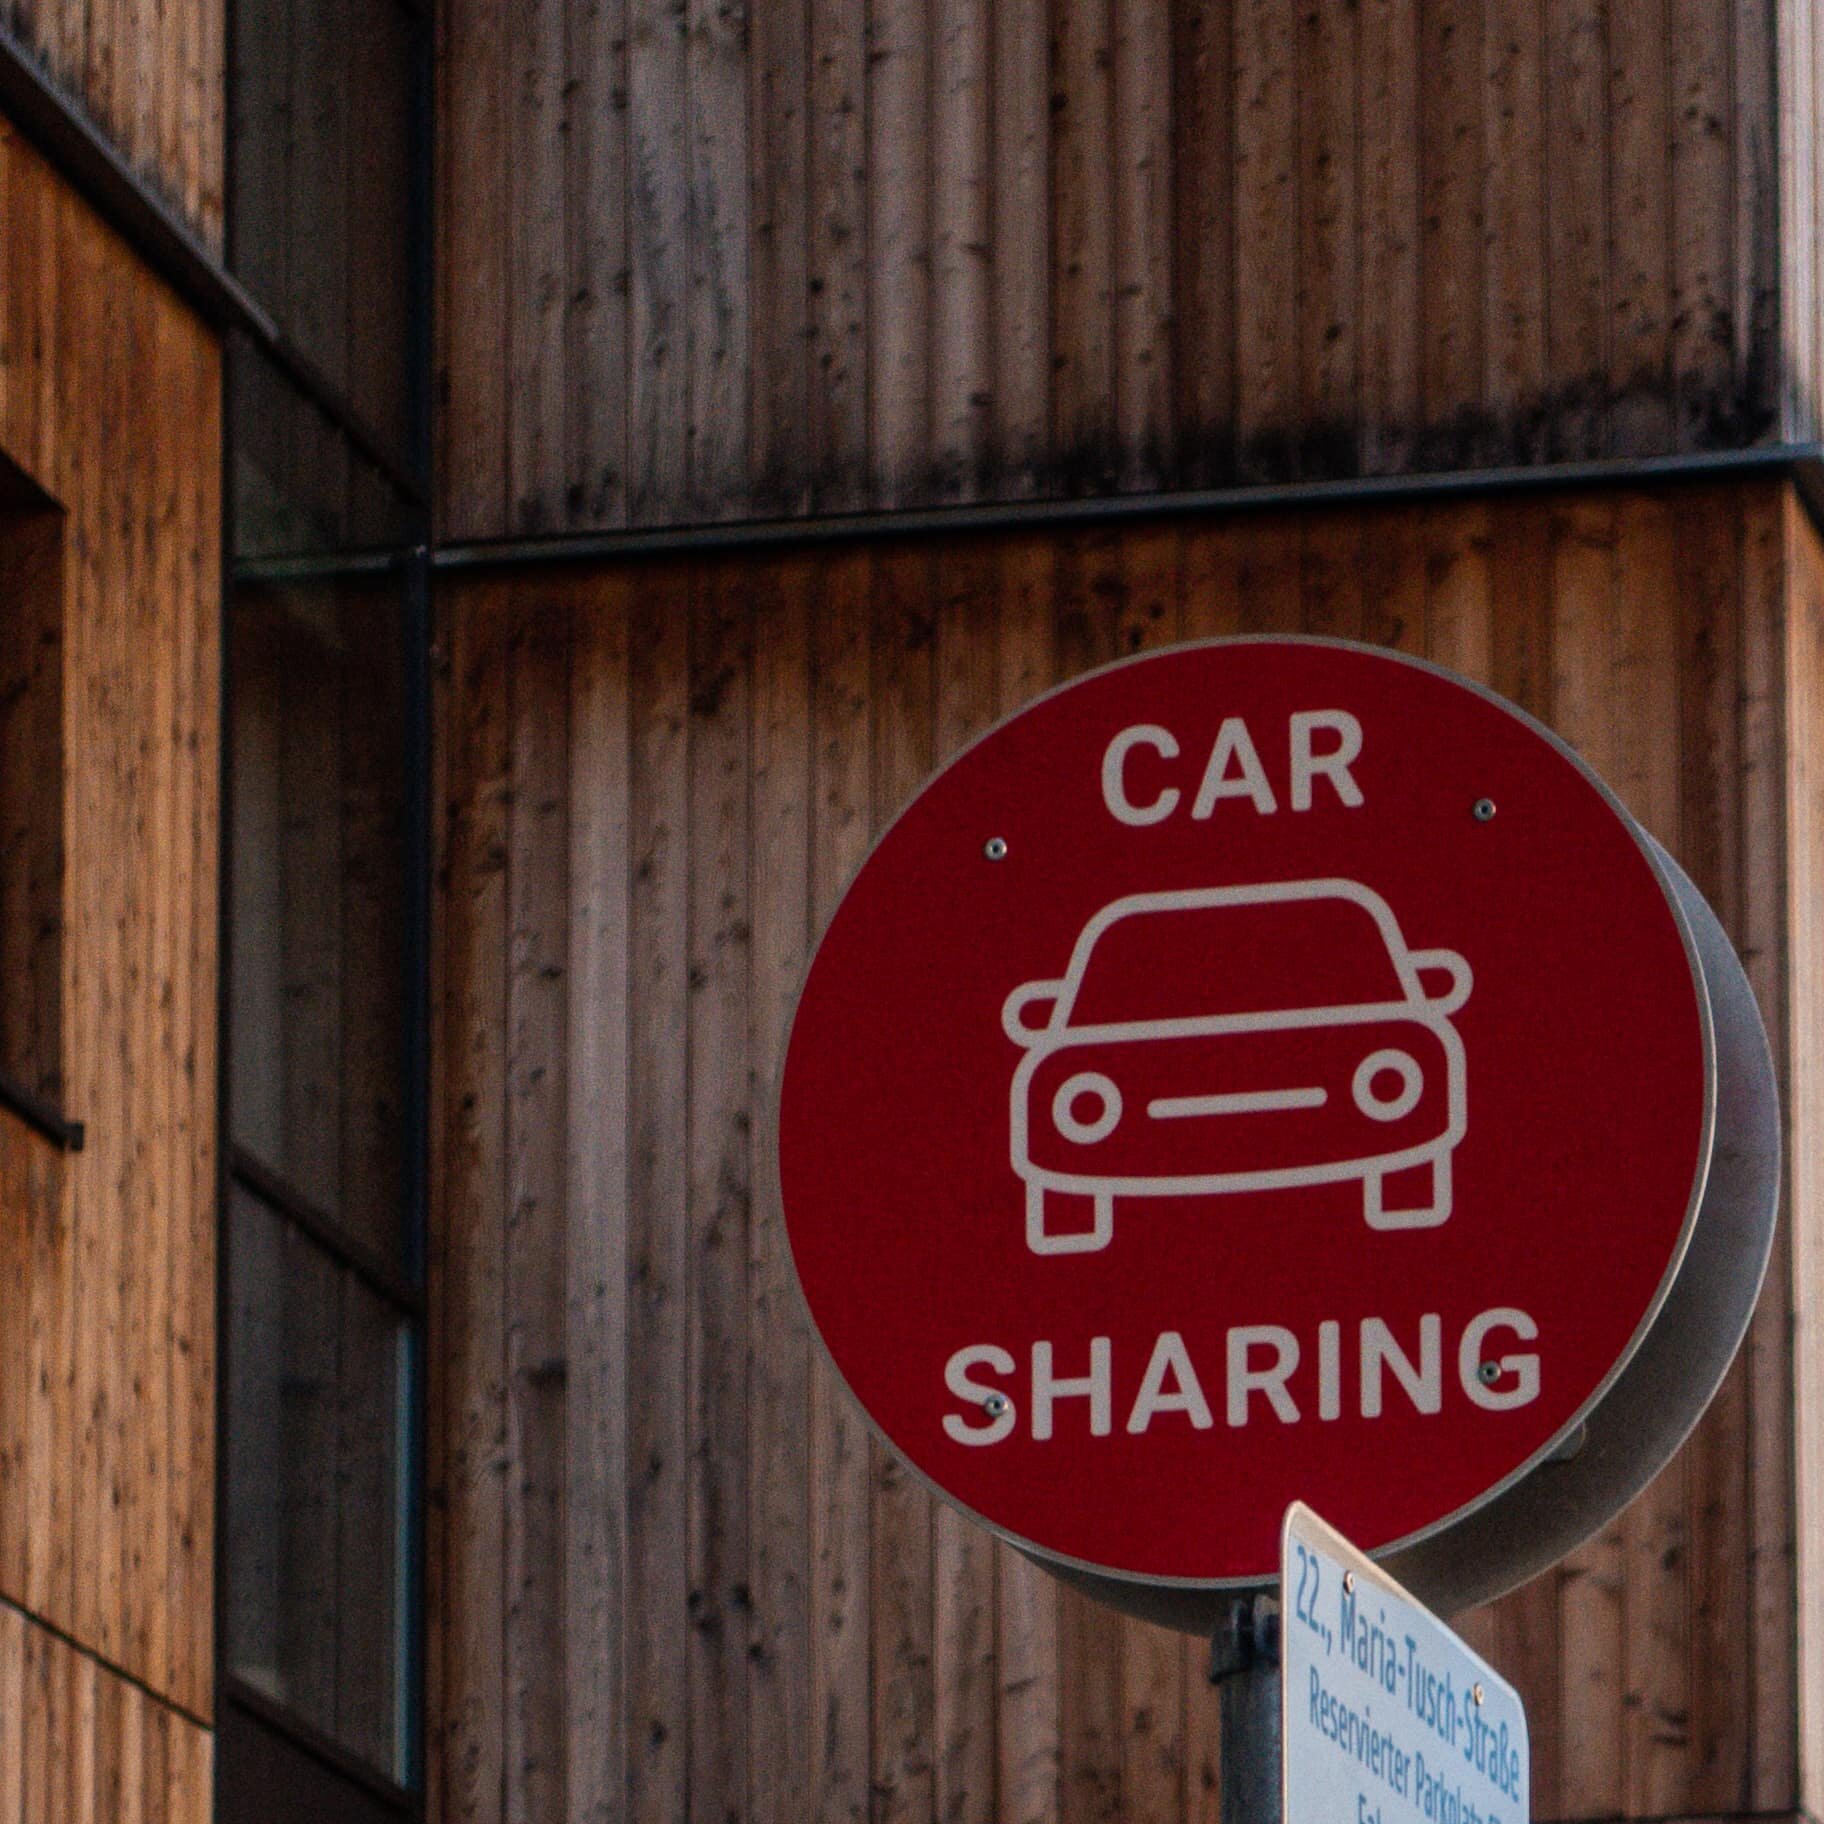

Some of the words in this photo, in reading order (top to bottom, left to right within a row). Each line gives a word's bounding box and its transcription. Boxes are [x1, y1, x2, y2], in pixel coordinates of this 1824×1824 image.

[1101, 708, 1364, 827] CAR
[940, 1307, 1543, 1448] SHARING
[1309, 1664, 1411, 1798] Reservierter
[1340, 1587, 1521, 1804] Maria-Tusch-Straße
